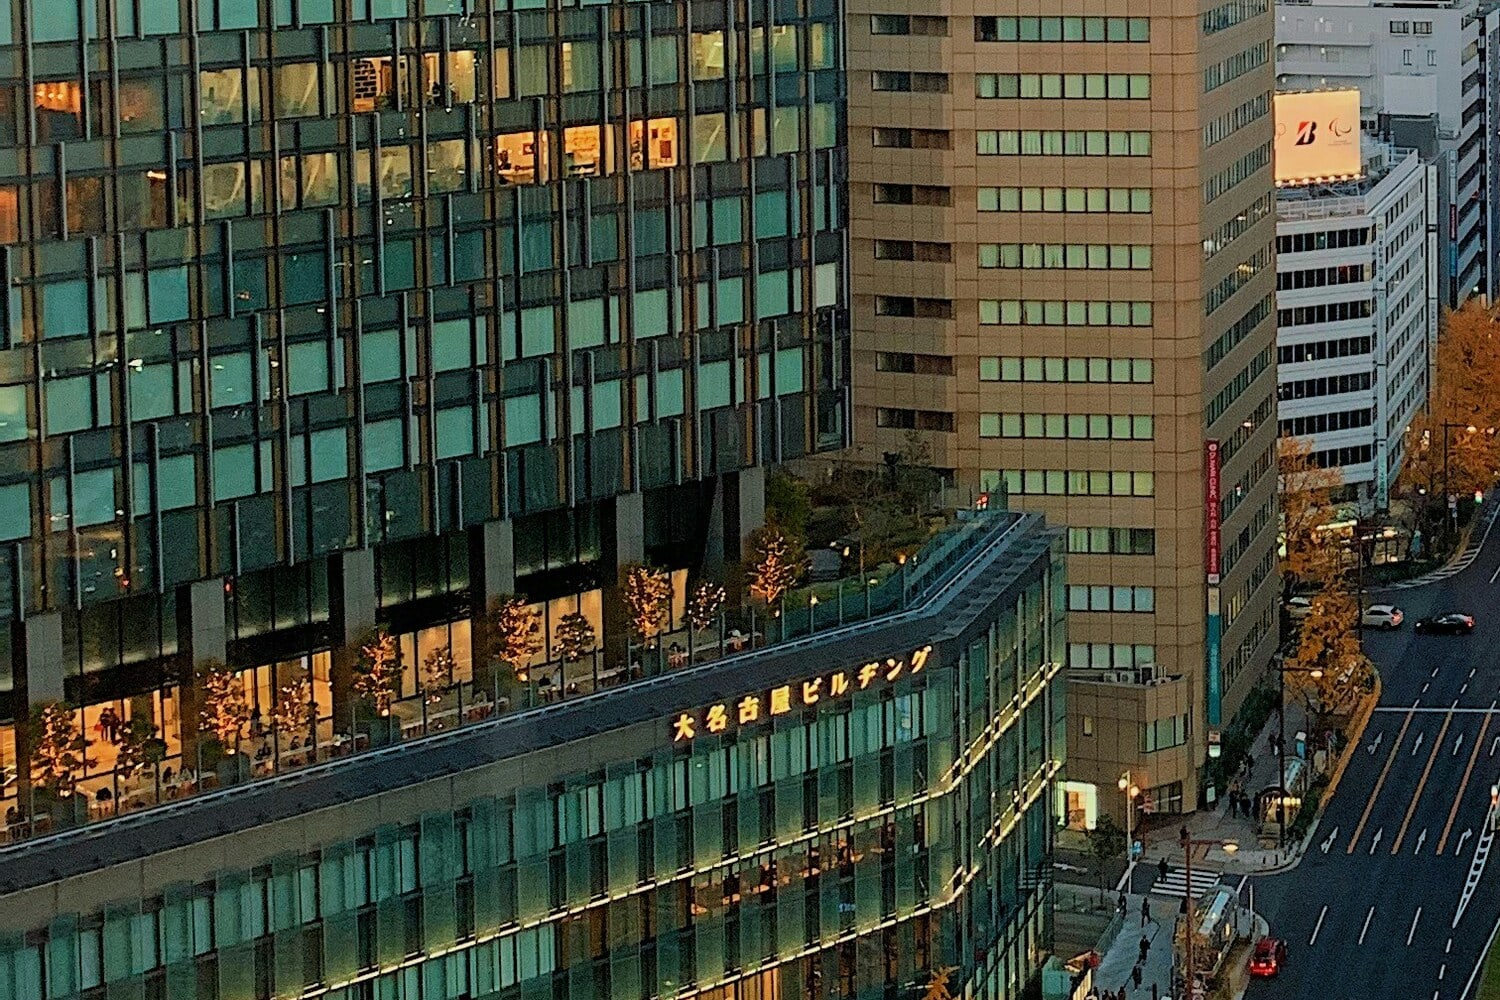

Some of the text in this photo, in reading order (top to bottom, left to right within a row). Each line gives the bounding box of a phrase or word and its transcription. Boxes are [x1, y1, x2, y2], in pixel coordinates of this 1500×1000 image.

[673, 644, 933, 742] 大名古屋ビルヂング
